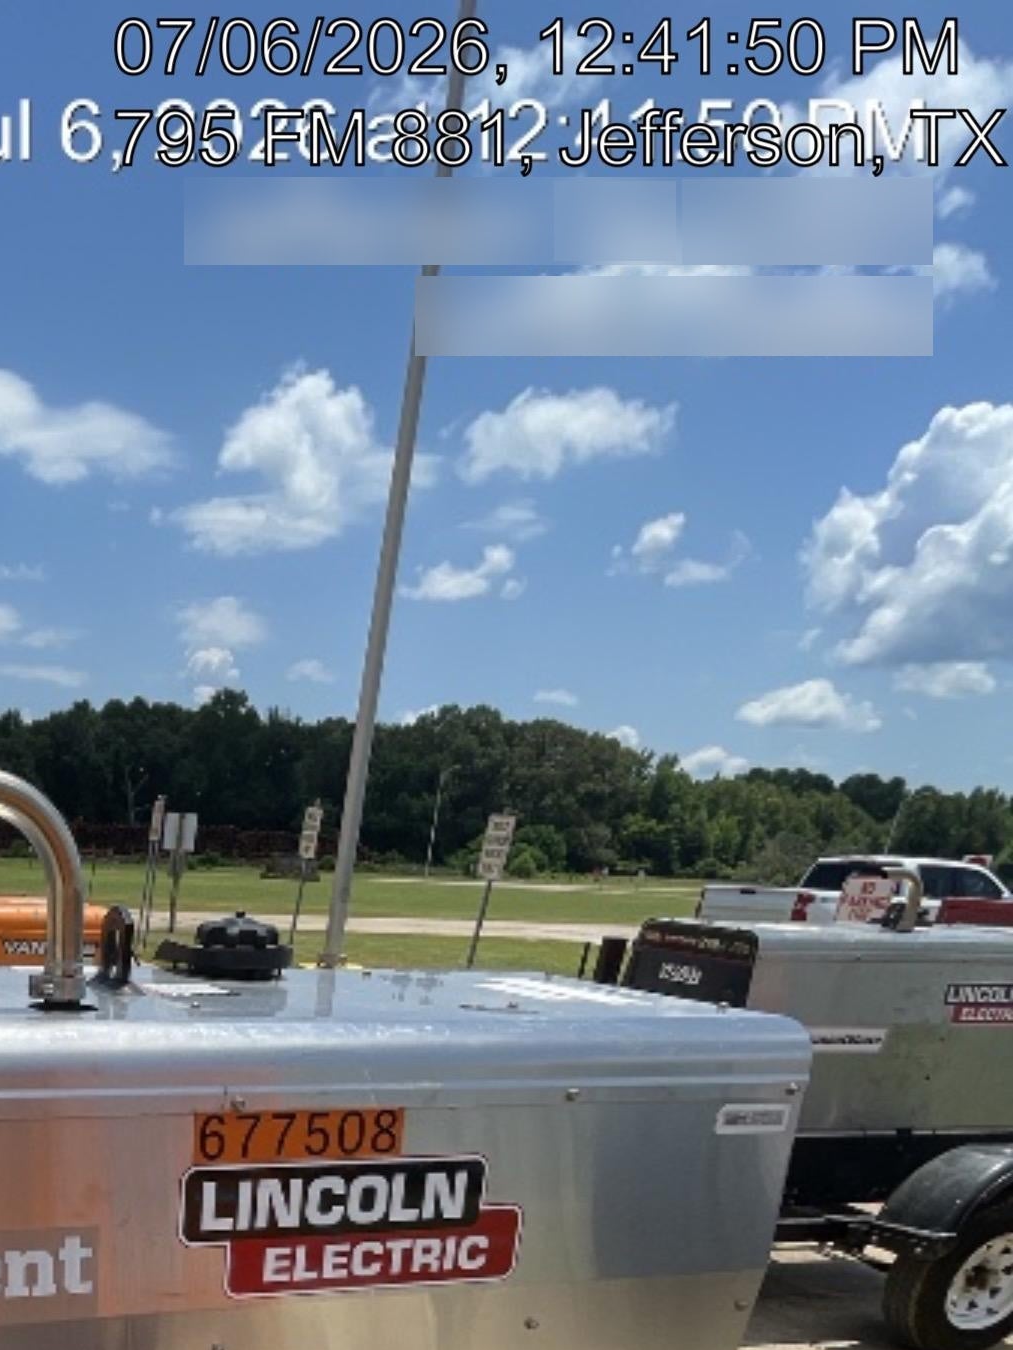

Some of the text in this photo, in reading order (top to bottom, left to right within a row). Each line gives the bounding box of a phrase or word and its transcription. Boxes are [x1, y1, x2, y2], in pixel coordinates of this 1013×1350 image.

[199, 1108, 397, 1161] 677508
[199, 1170, 468, 1232] LINCOLN
[262, 1235, 488, 1282] ELECTRIC
